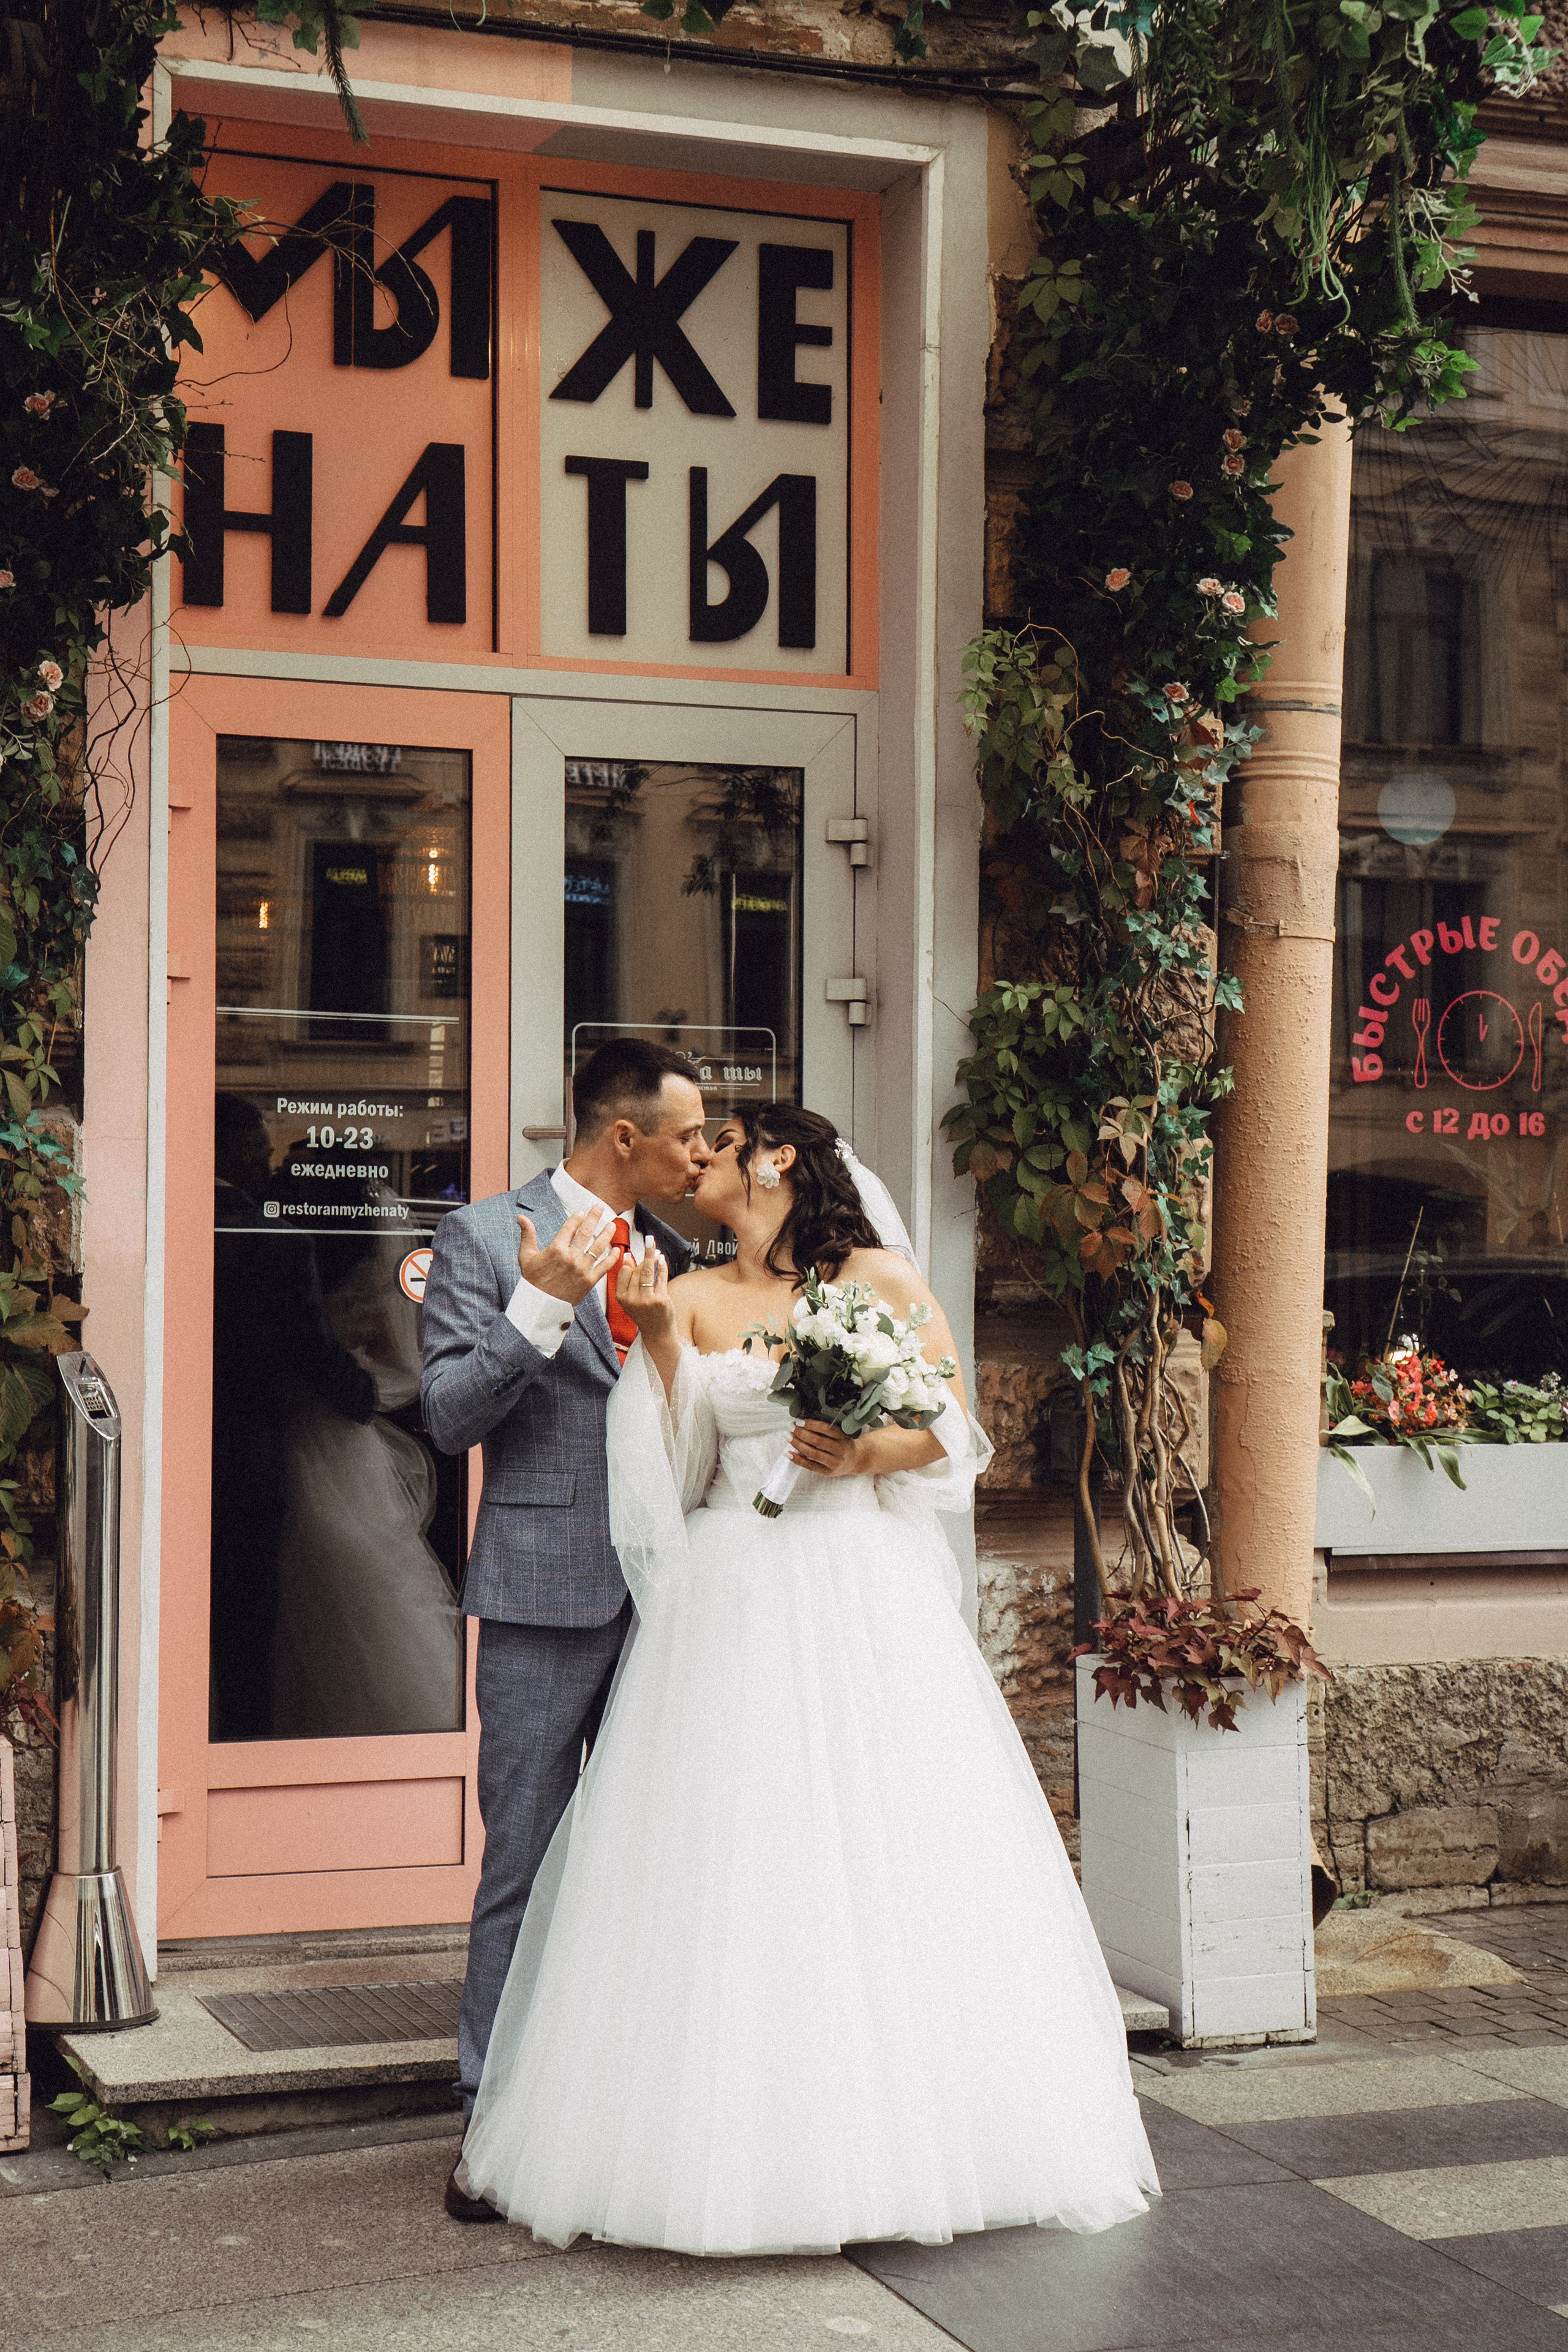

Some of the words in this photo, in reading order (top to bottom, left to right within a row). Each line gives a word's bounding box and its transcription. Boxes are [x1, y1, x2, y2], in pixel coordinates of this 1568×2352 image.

[549, 218, 834, 424] ЖЕ
[183, 421, 466, 624] НА
[565, 455, 816, 649] ТЫ
[1352, 916, 1501, 1082] БЫСТРЫЕ
[723, 1066, 763, 1081] ты
[277, 1098, 333, 1115] Режим
[337, 1099, 404, 1118] работы:
[1406, 1110, 1425, 1134] С
[1433, 1107, 1460, 1134] 12
[1467, 1112, 1510, 1140] ДО
[1519, 1112, 1545, 1136] 16
[307, 1126, 374, 1149] 10-23
[291, 1164, 388, 1179] ежедневно
[282, 1202, 409, 1219] restoranmyzhenaty
